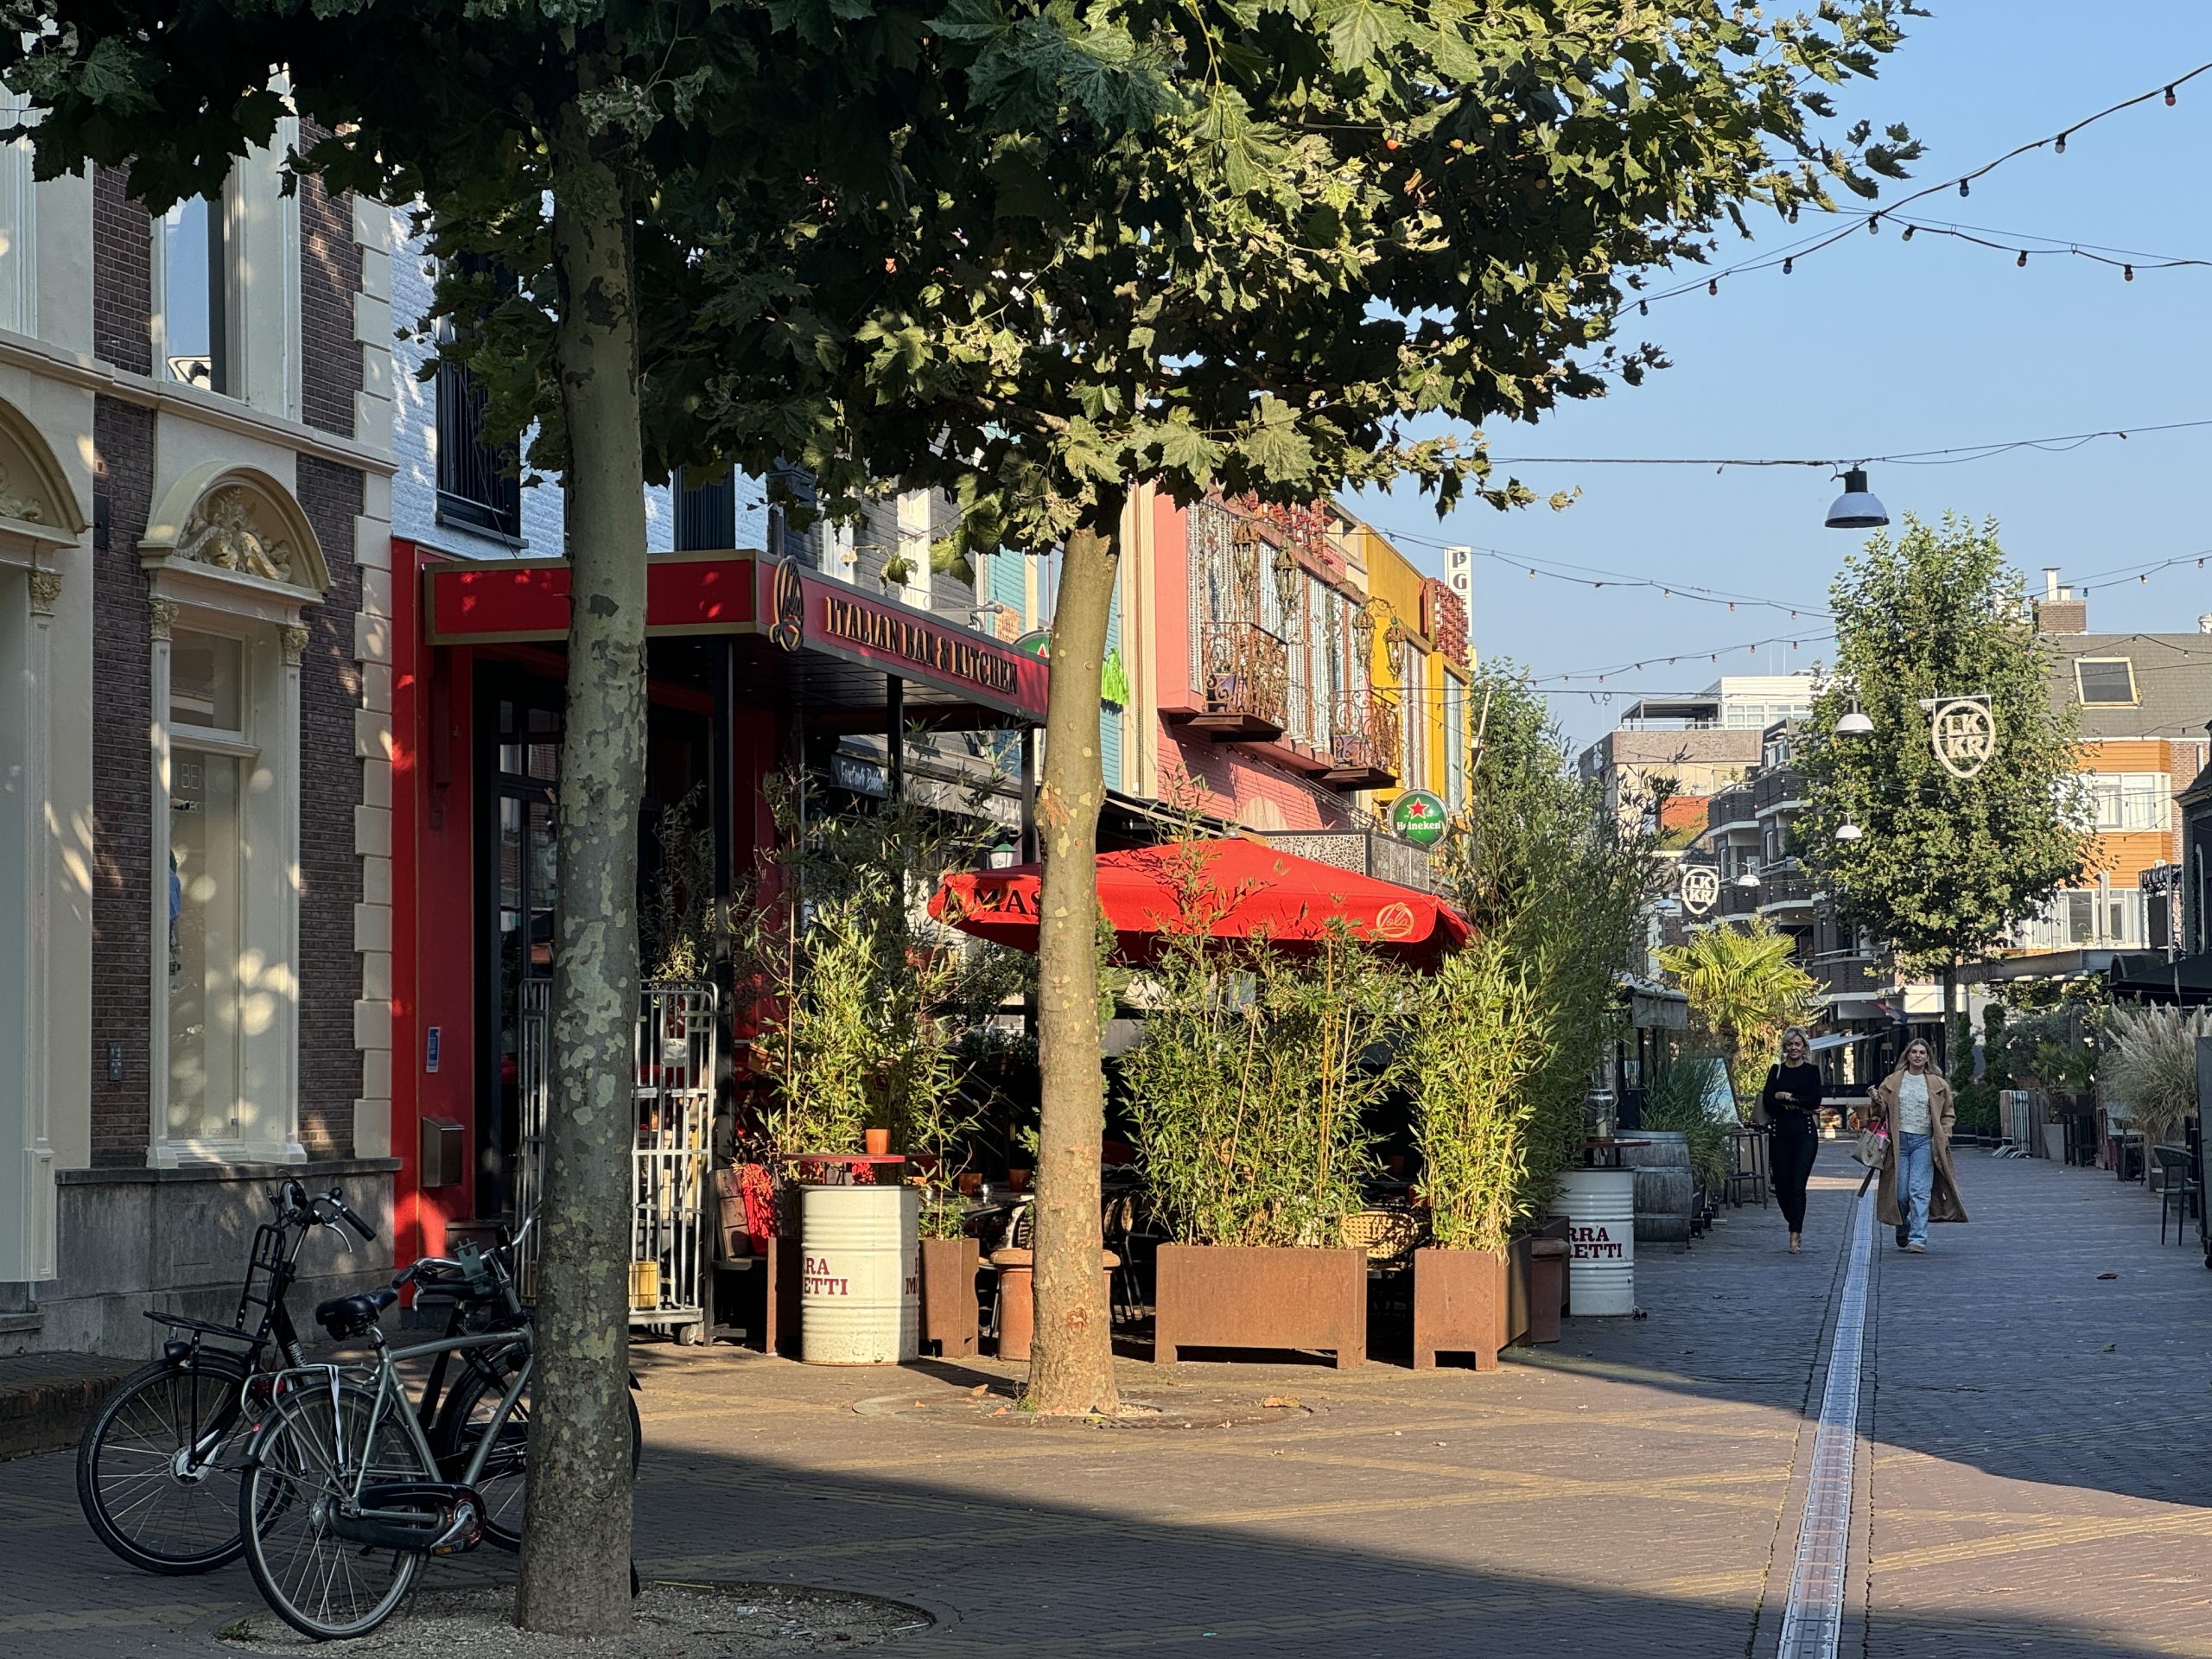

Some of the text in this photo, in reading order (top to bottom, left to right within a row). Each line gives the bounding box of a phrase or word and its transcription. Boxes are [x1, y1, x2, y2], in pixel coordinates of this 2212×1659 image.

[826, 596, 1018, 694] ITALIAN BAR & KITCHEN
[1396, 820, 1441, 830] Heineken
